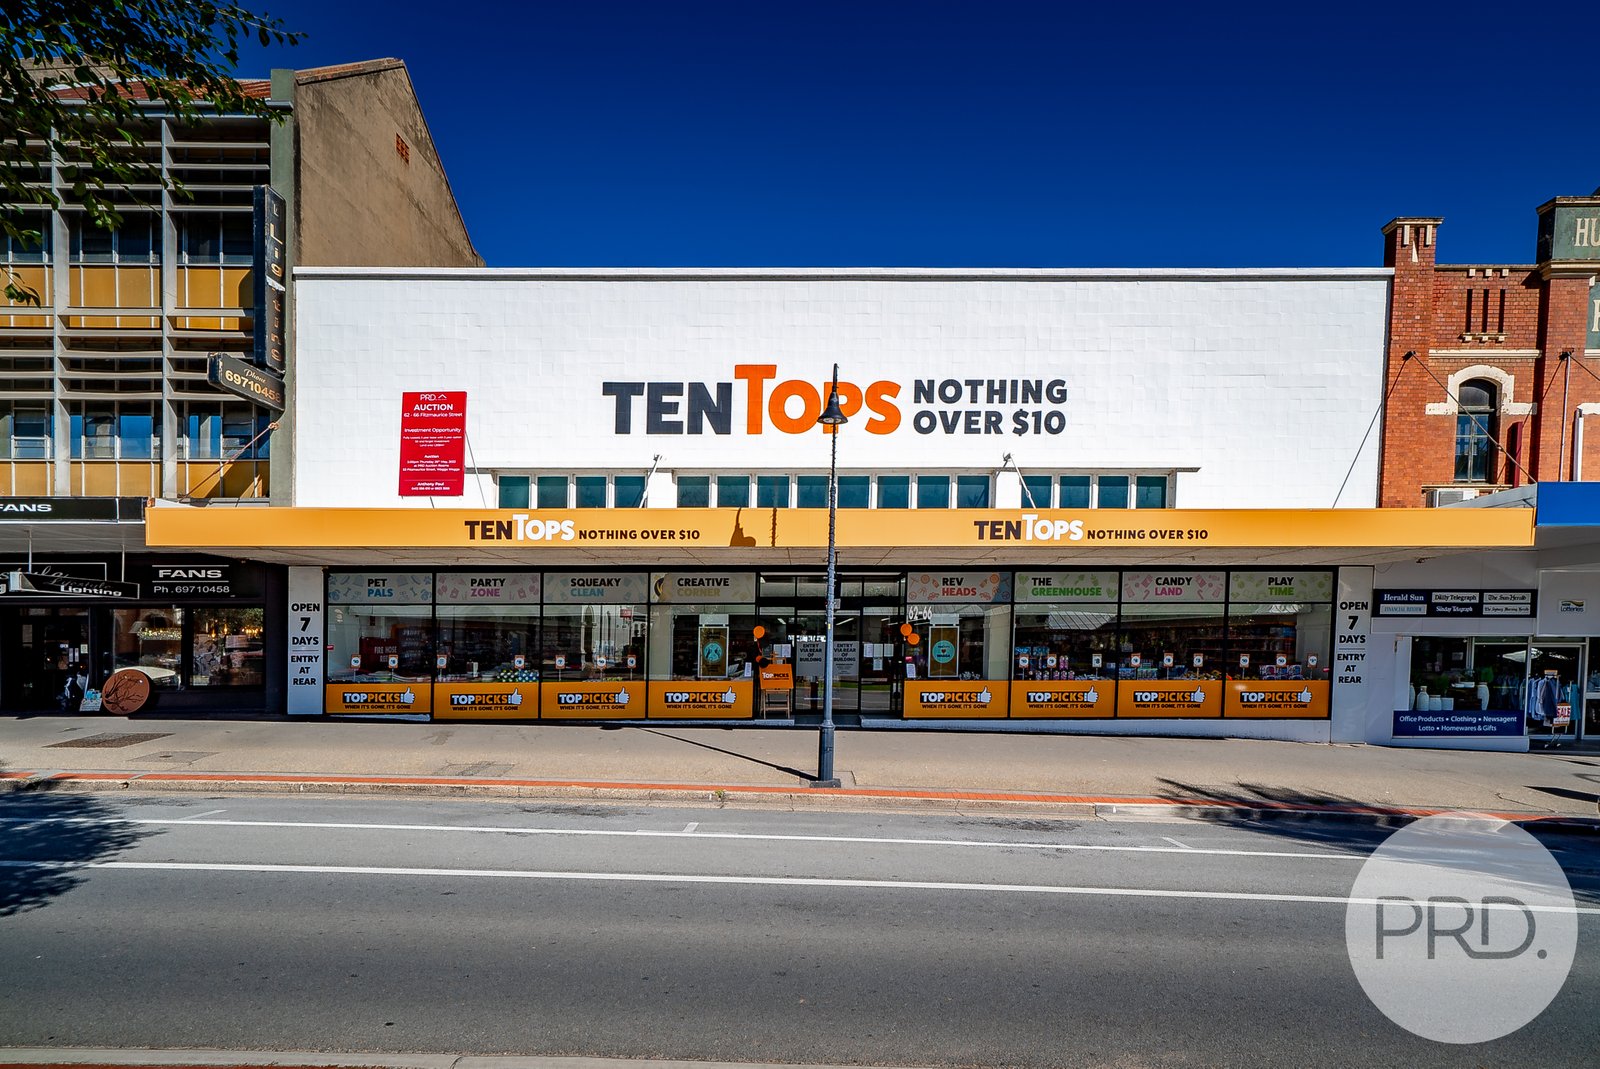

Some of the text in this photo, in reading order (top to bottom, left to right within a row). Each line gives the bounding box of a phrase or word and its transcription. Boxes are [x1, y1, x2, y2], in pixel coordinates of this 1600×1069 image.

[243, 368, 266, 384] Phone
[913, 379, 1068, 405] NOTHING
[414, 403, 454, 411] AUCTION
[913, 408, 1067, 437] OVER $10
[579, 529, 638, 540] NOTHING
[640, 529, 676, 540] OVER
[679, 529, 700, 541] $10
[1087, 529, 1145, 540] NOTHING
[1149, 529, 1184, 540] OVER
[1187, 529, 1208, 541] $10
[159, 569, 222, 578] FANS
[367, 578, 388, 587] PET
[470, 578, 506, 587] PARTY
[570, 578, 621, 587] SQUEAKY
[677, 578, 730, 587] CREATIVE
[942, 577, 964, 586] REV
[1031, 577, 1052, 586] THE
[1155, 577, 1193, 586] CANDY
[1268, 577, 1294, 585] PLAY
[60, 584, 123, 597] Lighting
[367, 588, 394, 597] PALS
[470, 588, 501, 597] ZONE
[570, 588, 604, 597] CLEAN
[677, 588, 721, 597] CORNER
[941, 587, 977, 597] HEADS
[1031, 587, 1102, 597] GREENHOUSE
[1154, 587, 1183, 596] LAND
[1268, 587, 1294, 596] TIME
[1384, 593, 1425, 601] Herald Sun
[291, 603, 320, 612] OPEN
[1340, 601, 1369, 610] OPEN
[908, 606, 933, 620] 62-66
[300, 617, 311, 632] 7
[1348, 616, 1359, 630] 7
[292, 636, 319, 645] DAYS
[1339, 635, 1366, 644] DAYS
[290, 655, 320, 663] ENTRY
[1337, 653, 1366, 661] ENTRY
[299, 666, 311, 674] AT
[293, 678, 317, 686] REAR
[1338, 676, 1362, 684] REAR
[1557, 707, 1570, 718] SALE
[1450, 715, 1477, 723] Clothing
